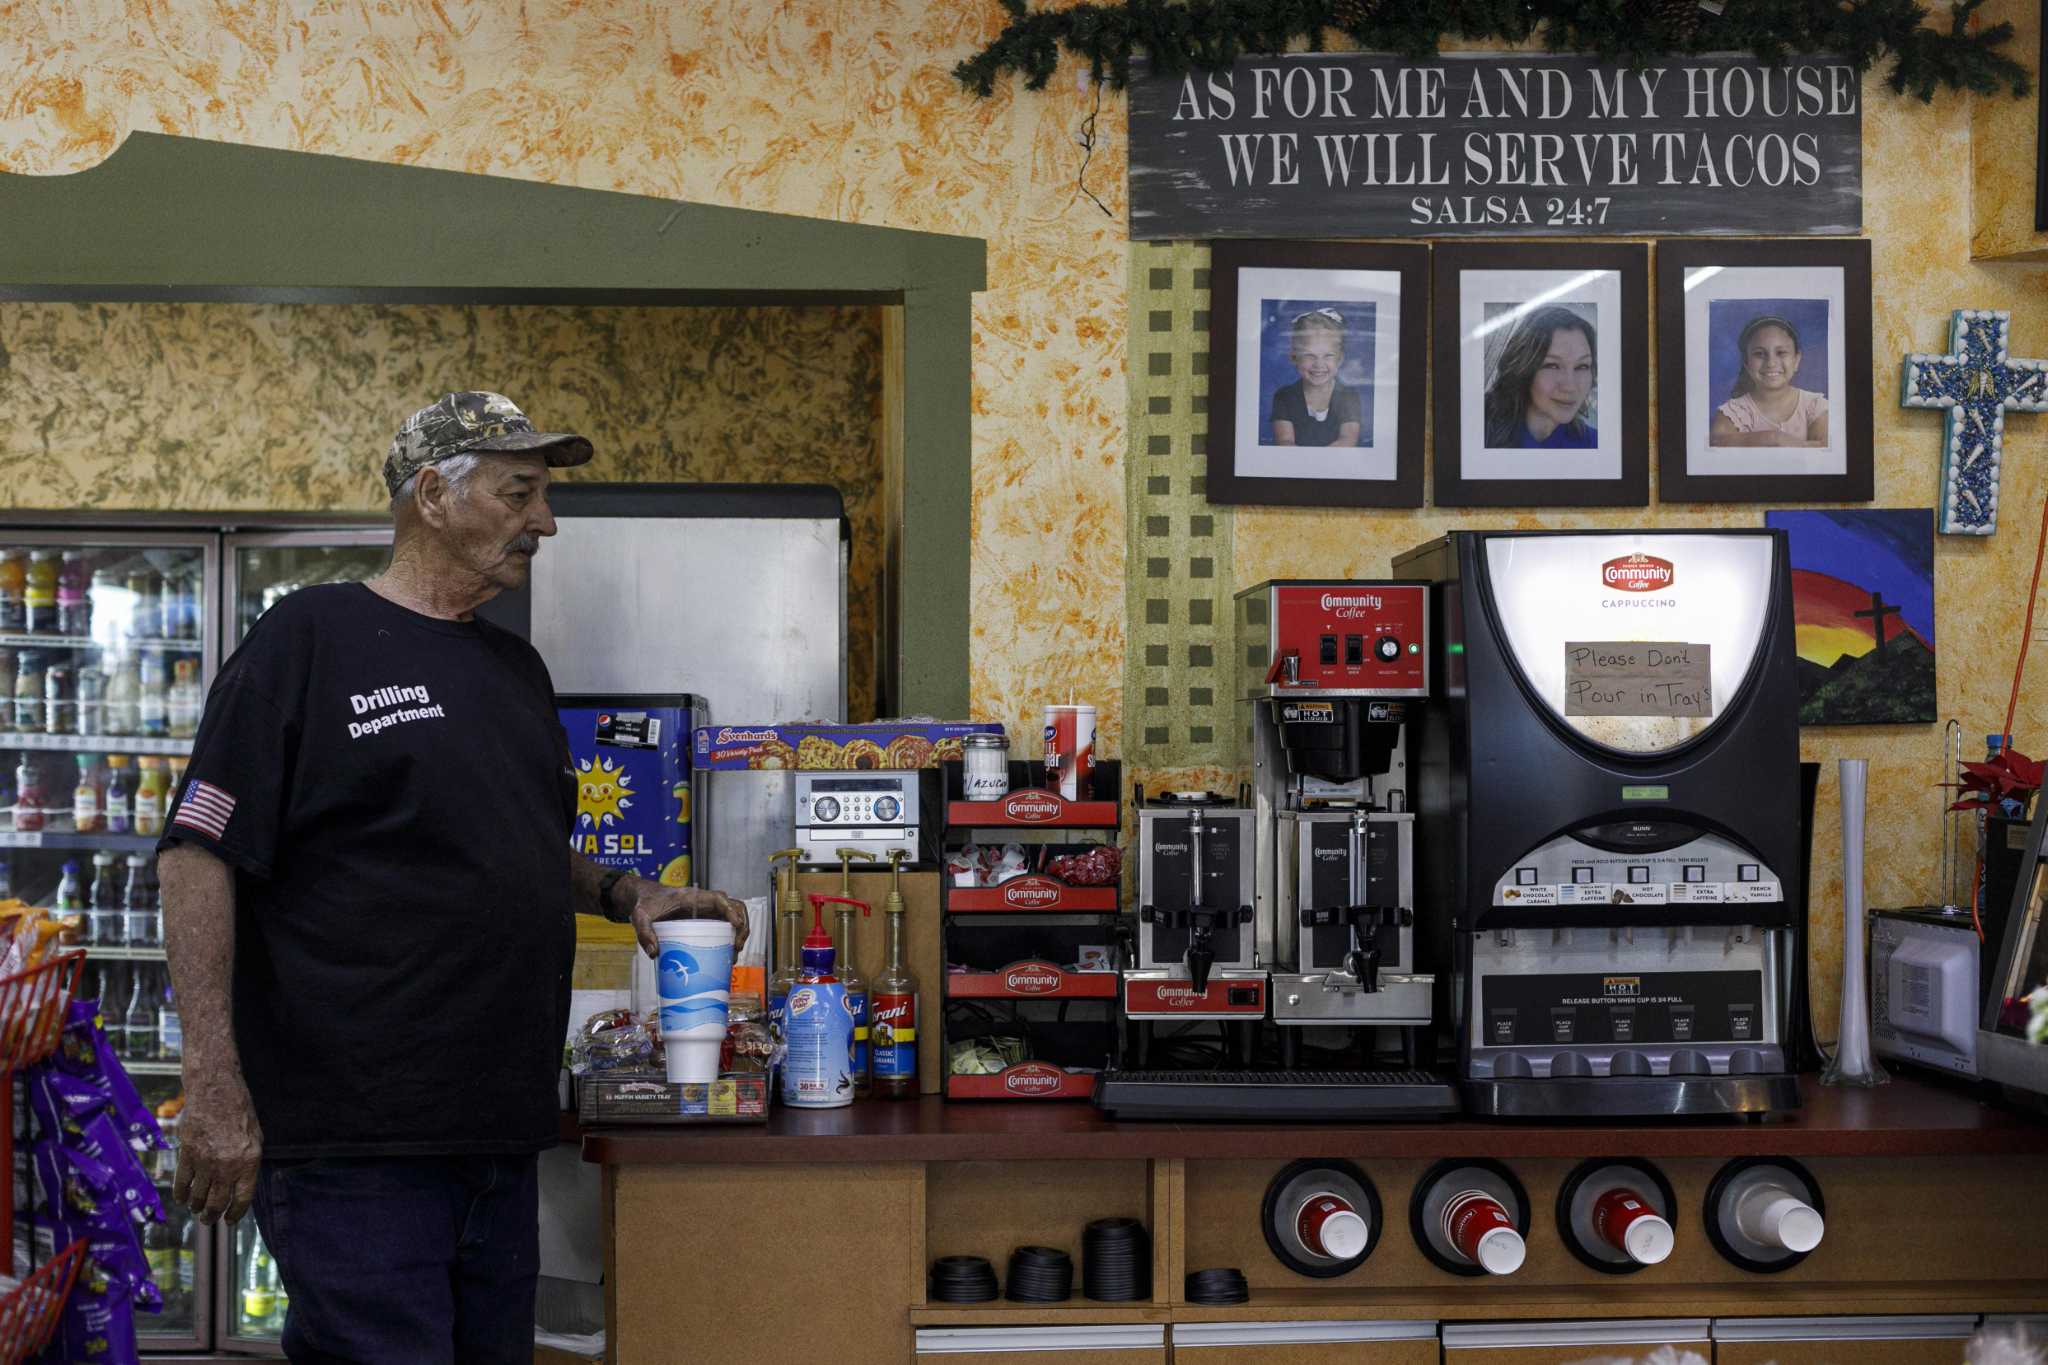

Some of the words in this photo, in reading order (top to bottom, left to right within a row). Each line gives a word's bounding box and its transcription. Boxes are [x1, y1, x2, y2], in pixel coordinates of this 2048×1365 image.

[1172, 68, 1236, 121] AS
[1252, 67, 1357, 119] FOR
[1370, 67, 1447, 119] ME
[1460, 66, 1574, 119] AND
[1587, 66, 1668, 119] MY
[1683, 65, 1857, 118] HOUSE
[1219, 132, 1300, 187] WE
[1313, 132, 1451, 187] WILL
[1463, 131, 1640, 187] SERVE
[1652, 131, 1821, 188] TACOS
[1410, 196, 1534, 225] SALSA
[1546, 196, 1611, 226] 24:7
[1605, 565, 1672, 583] Community
[1627, 580, 1650, 590] Coffee
[1321, 593, 1382, 611] Community
[1601, 599, 1676, 608] CAPPUCCINO
[1336, 606, 1366, 619] Coffee
[1569, 646, 1637, 668] Please
[1570, 679, 1627, 705] Pour
[1640, 689, 1657, 704] in
[350, 685, 430, 715] Drilling
[347, 703, 445, 739] Department
[716, 728, 778, 745] Svenhard's
[1008, 801, 1058, 815] Community
[1155, 842, 1188, 853] Community
[1315, 847, 1347, 858] Community
[1008, 888, 1058, 901] Community
[1008, 974, 1058, 987] Community
[1169, 998, 1195, 1009] Coffee
[1008, 1075, 1058, 1088] Community
